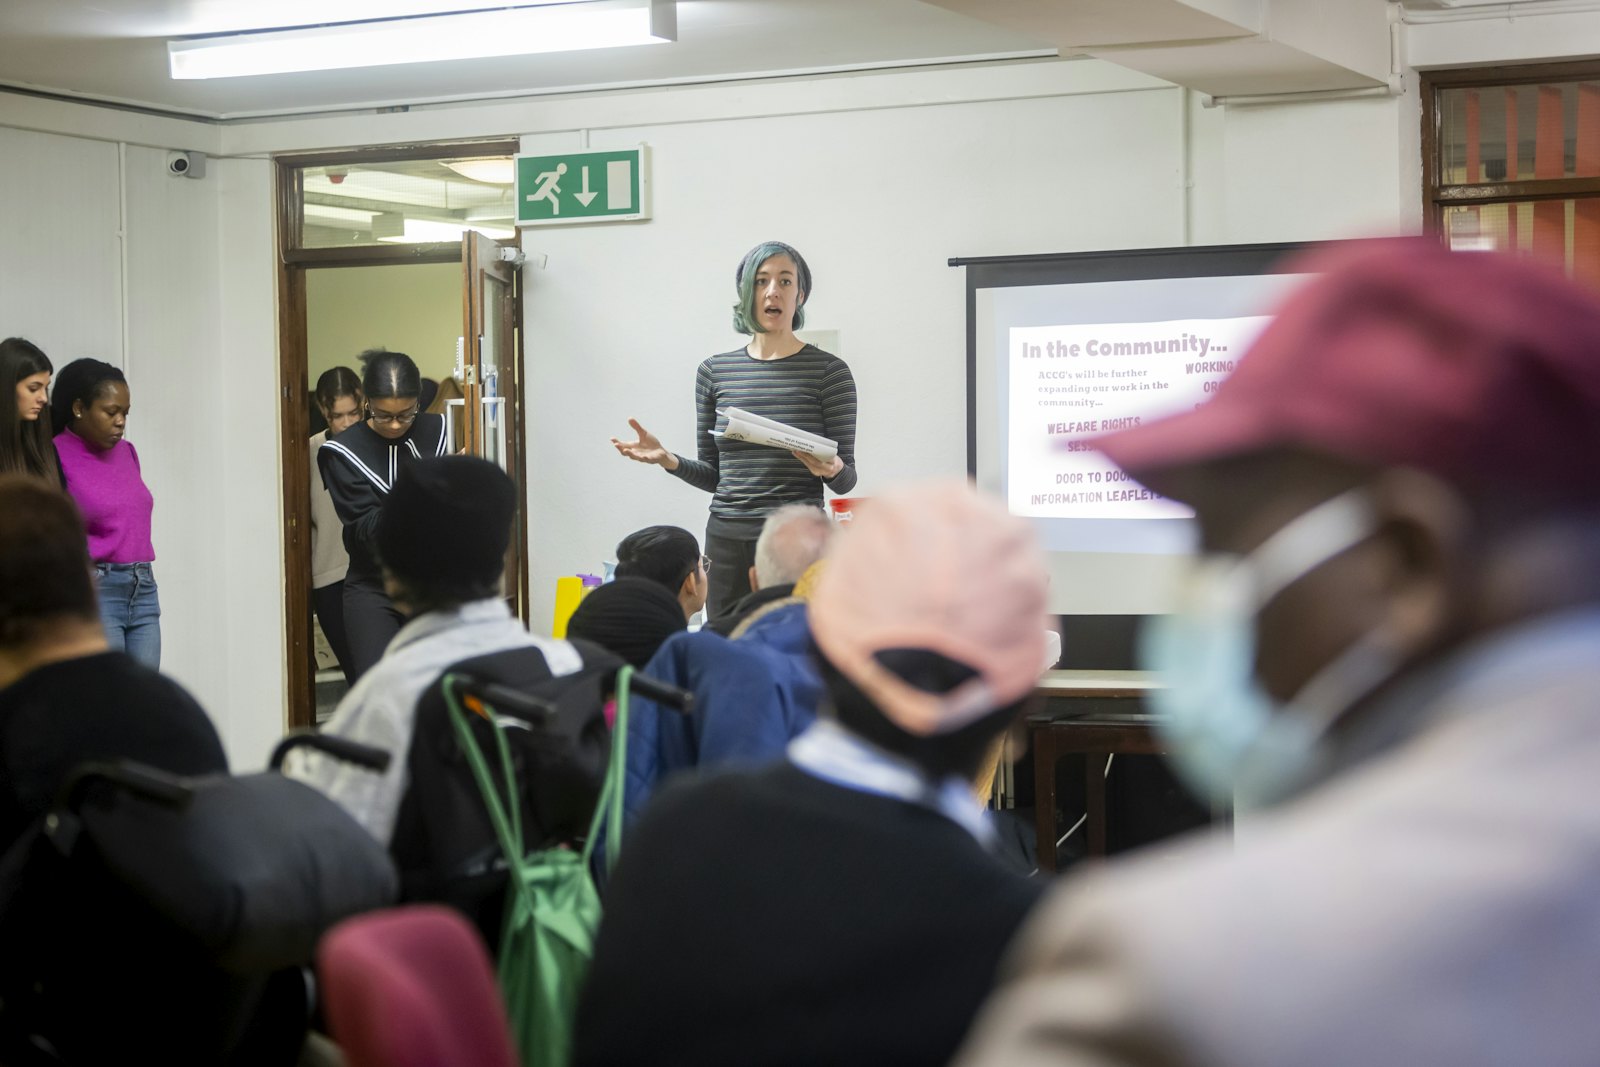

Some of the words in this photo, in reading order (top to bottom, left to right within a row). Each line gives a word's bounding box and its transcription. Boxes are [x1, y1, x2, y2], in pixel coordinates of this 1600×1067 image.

[1022, 342, 1042, 358] In
[1046, 340, 1081, 358] the
[1085, 333, 1228, 358] Community...
[1038, 371, 1072, 380] ACCG's
[1075, 370, 1095, 379] will
[1097, 369, 1109, 379] be
[1110, 368, 1148, 378] further
[1185, 361, 1234, 375] WORKING
[1038, 385, 1091, 395] expanding
[1092, 384, 1109, 392] our
[1112, 382, 1137, 392] work
[1139, 382, 1150, 390] in
[1152, 381, 1169, 390] the
[1038, 398, 1104, 408] community...
[1047, 420, 1098, 435] WELFARE
[1101, 416, 1141, 431] RIGHTS
[1056, 473, 1083, 484] DOOR
[1087, 471, 1102, 483] TO
[1031, 491, 1103, 506] INFORMATION
